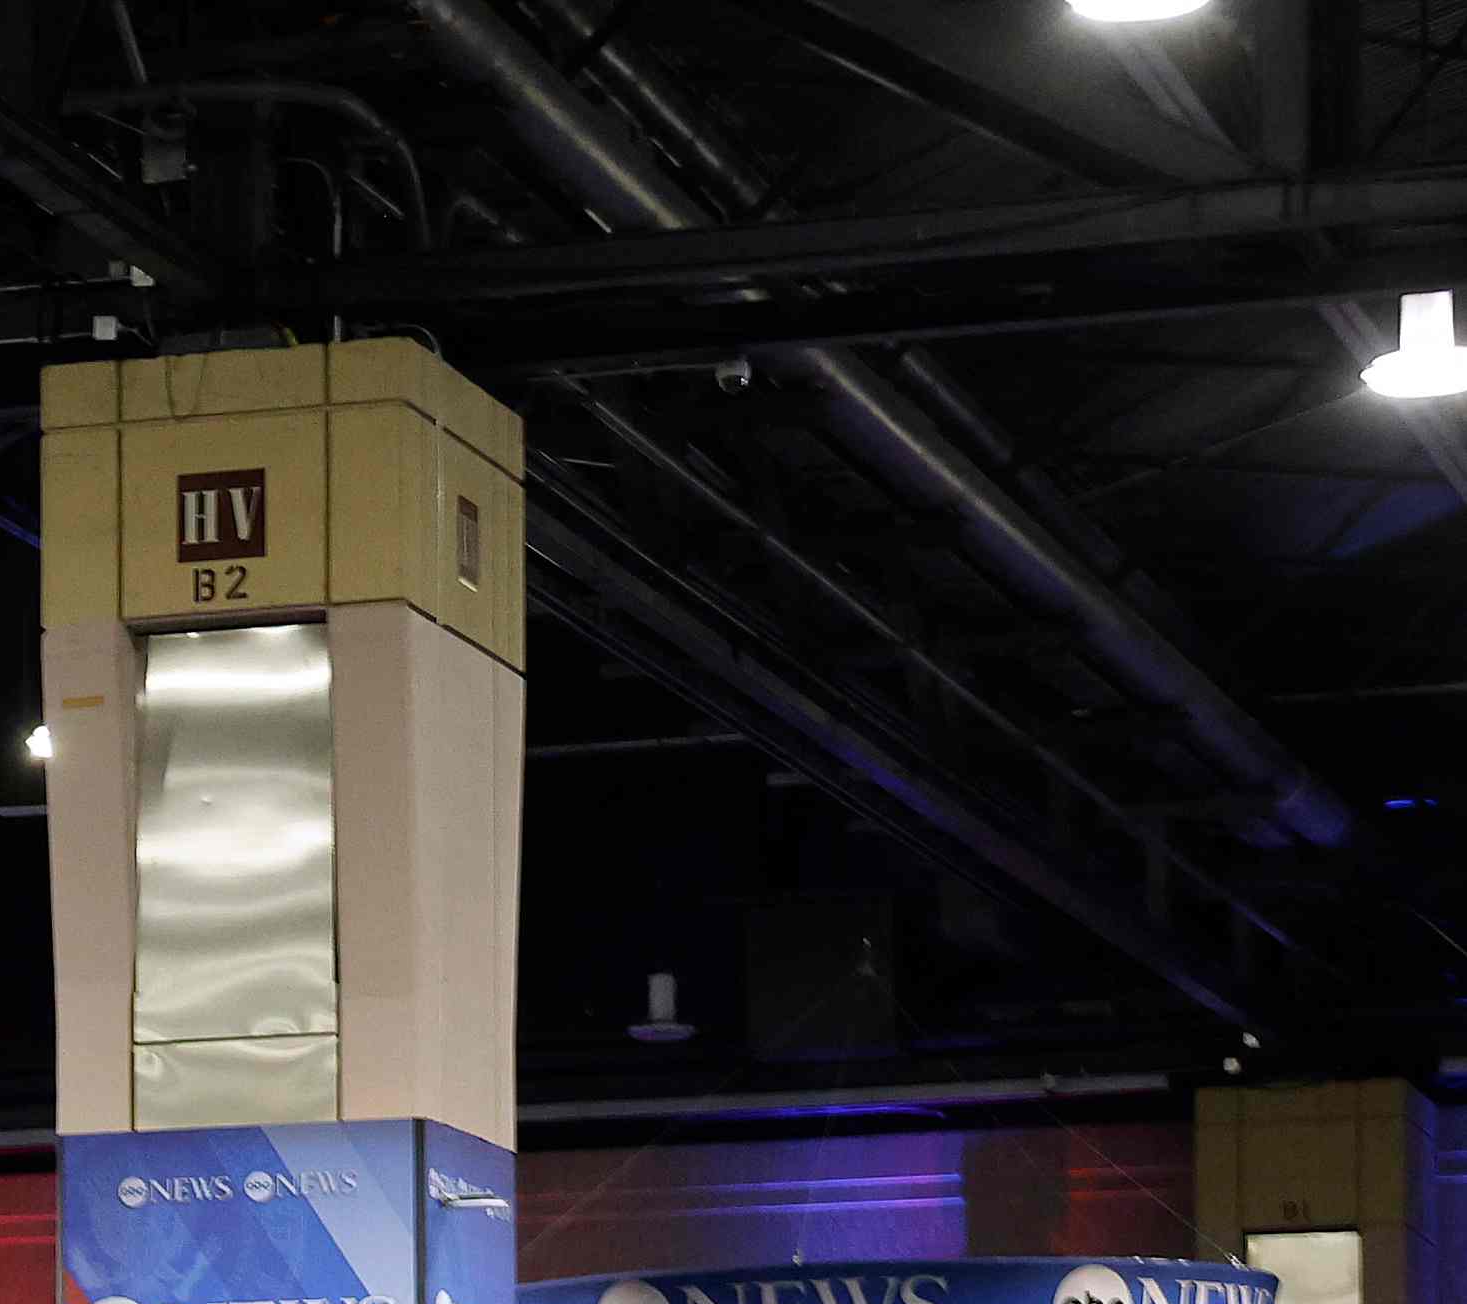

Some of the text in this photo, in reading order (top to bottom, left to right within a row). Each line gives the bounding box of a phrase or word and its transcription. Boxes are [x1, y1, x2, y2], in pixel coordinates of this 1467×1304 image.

[192, 565, 248, 603] B2
[150, 1175, 234, 1203] NEWS
[276, 1170, 359, 1197] NEWS
